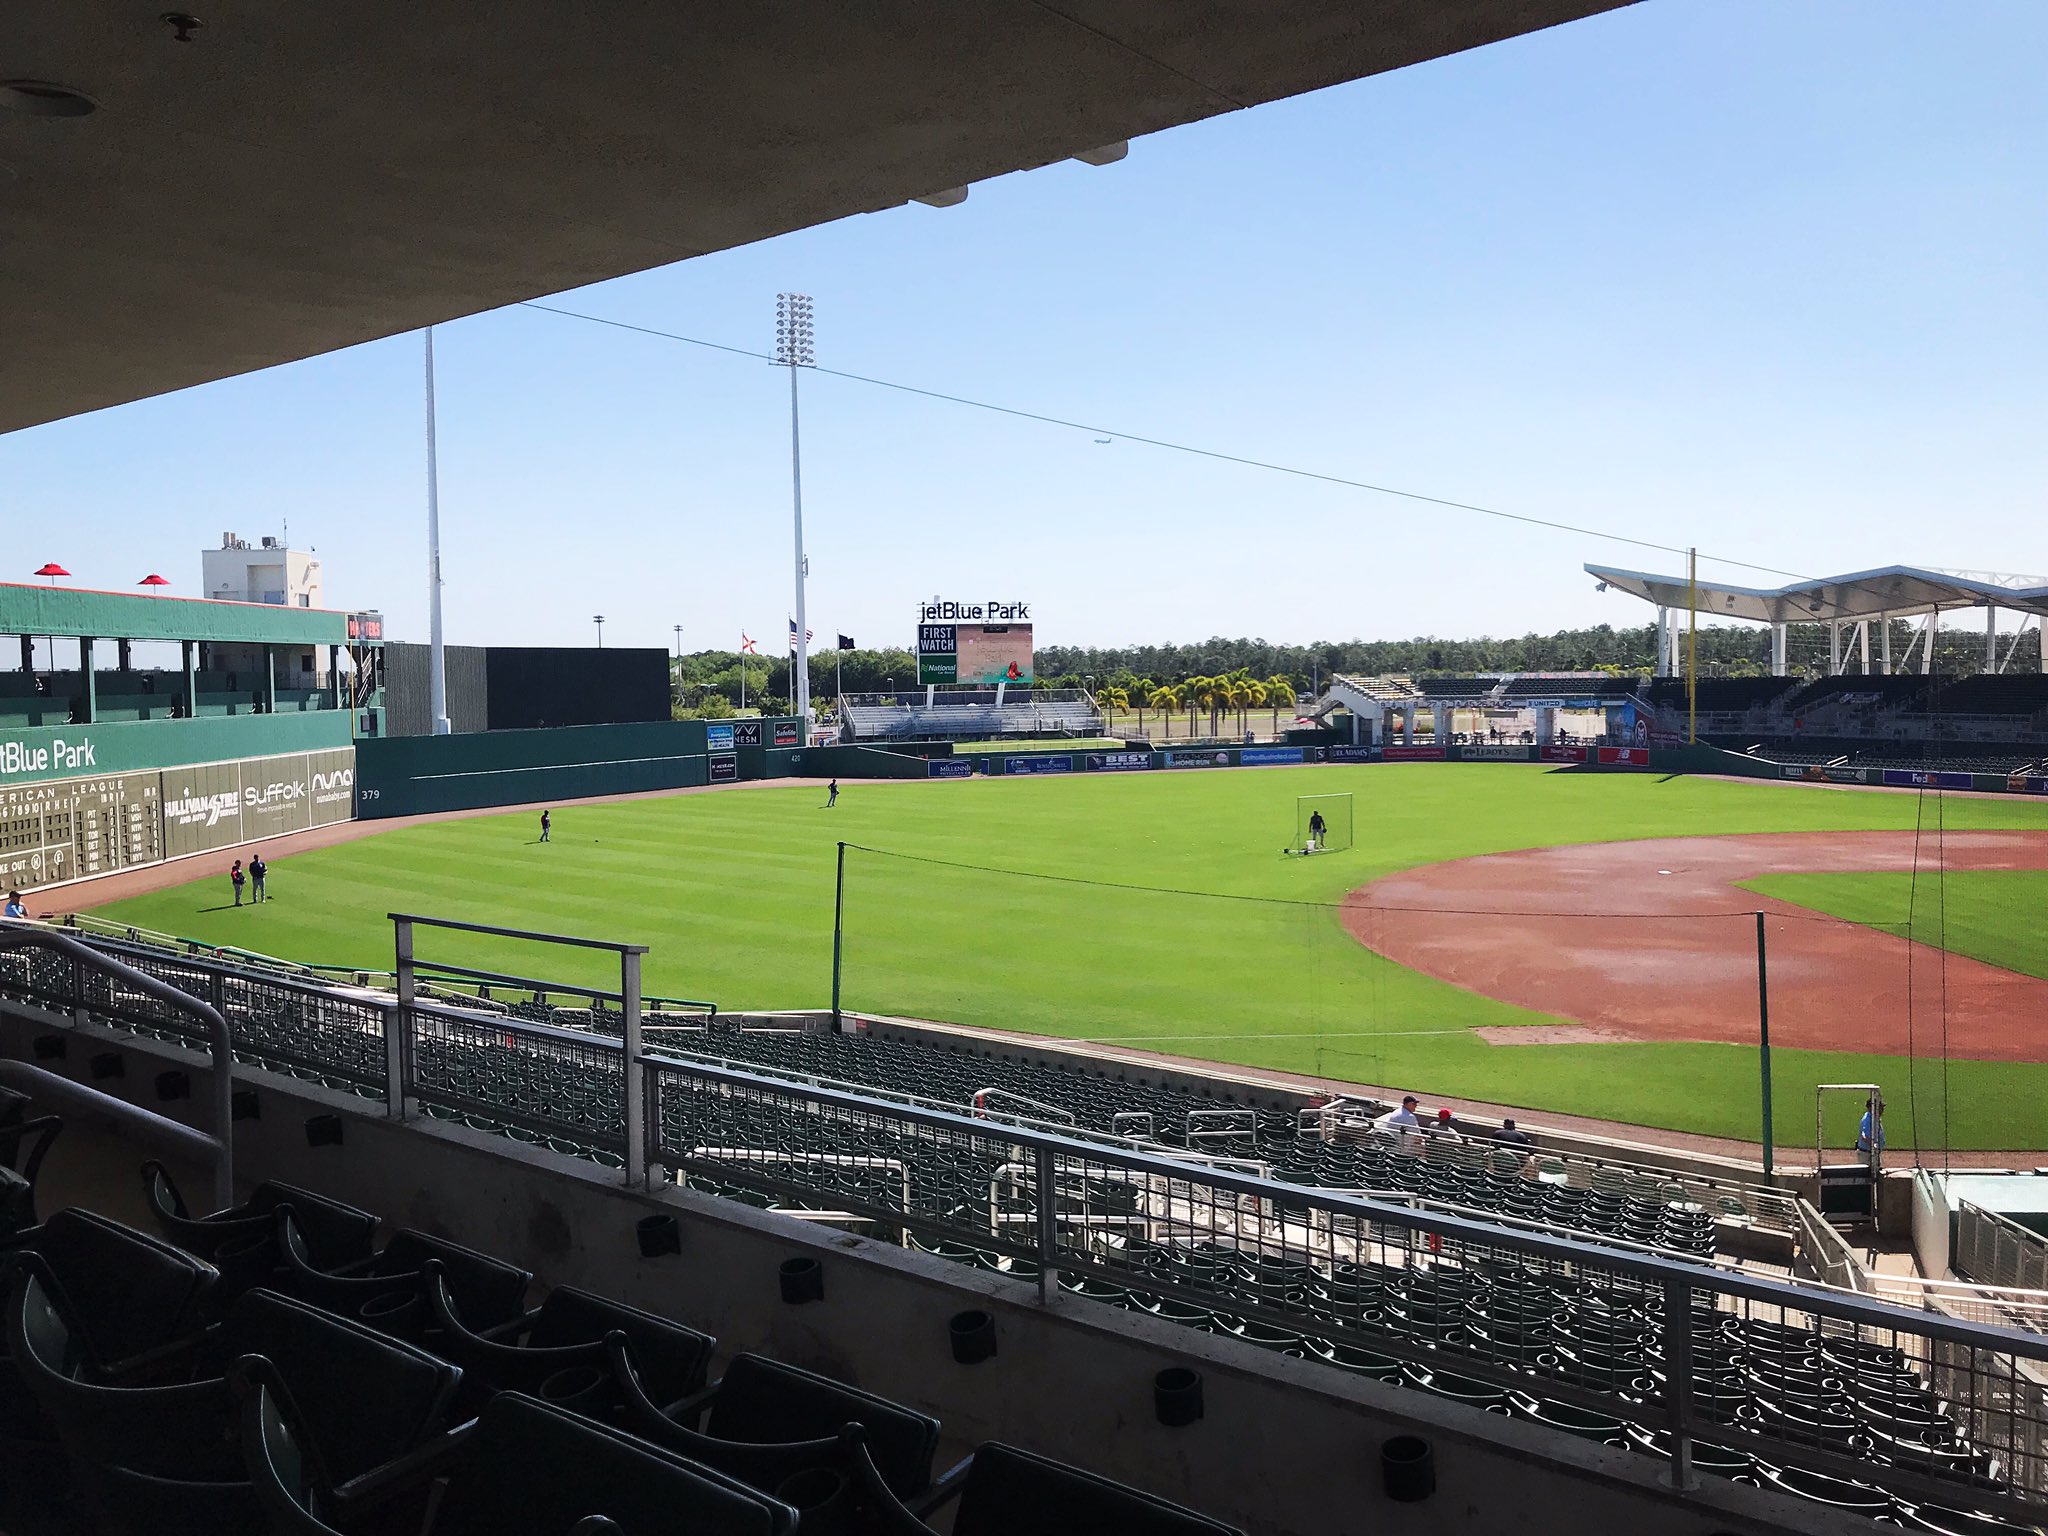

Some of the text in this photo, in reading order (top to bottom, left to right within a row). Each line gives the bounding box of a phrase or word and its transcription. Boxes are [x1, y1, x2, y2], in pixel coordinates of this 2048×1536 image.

[920, 601, 1029, 624] jetBlue Park
[923, 627, 952, 639] FIRST
[920, 639, 954, 651] WATCH
[928, 664, 956, 672] National
[776, 729, 796, 737] Safelite
[735, 735, 757, 744] NESN
[0, 737, 96, 774] tBlue Park
[1175, 752, 1214, 760] HEALTHCARE
[1344, 748, 1368, 756] ADAMS
[1106, 754, 1148, 763] BEST
[72, 780, 124, 795] LEAGUE
[120, 791, 124, 800] P
[152, 786, 156, 796] R
[244, 780, 306, 806] Suffolk
[76, 796, 80, 807] P
[110, 792, 114, 802] R
[220, 791, 239, 808] TIRE
[316, 790, 350, 804] nunababy.com
[362, 790, 380, 800] 379
[2, 802, 40, 818] 6 7 8 9 10
[46, 798, 68, 812] R H E
[131, 804, 141, 812] STL
[88, 810, 96, 819] PIT
[180, 807, 239, 825] AND AUTO SERVICE
[89, 820, 96, 829] TB
[88, 830, 98, 840] TOR
[88, 840, 98, 850] DET
[12, 860, 26, 872] OUT
